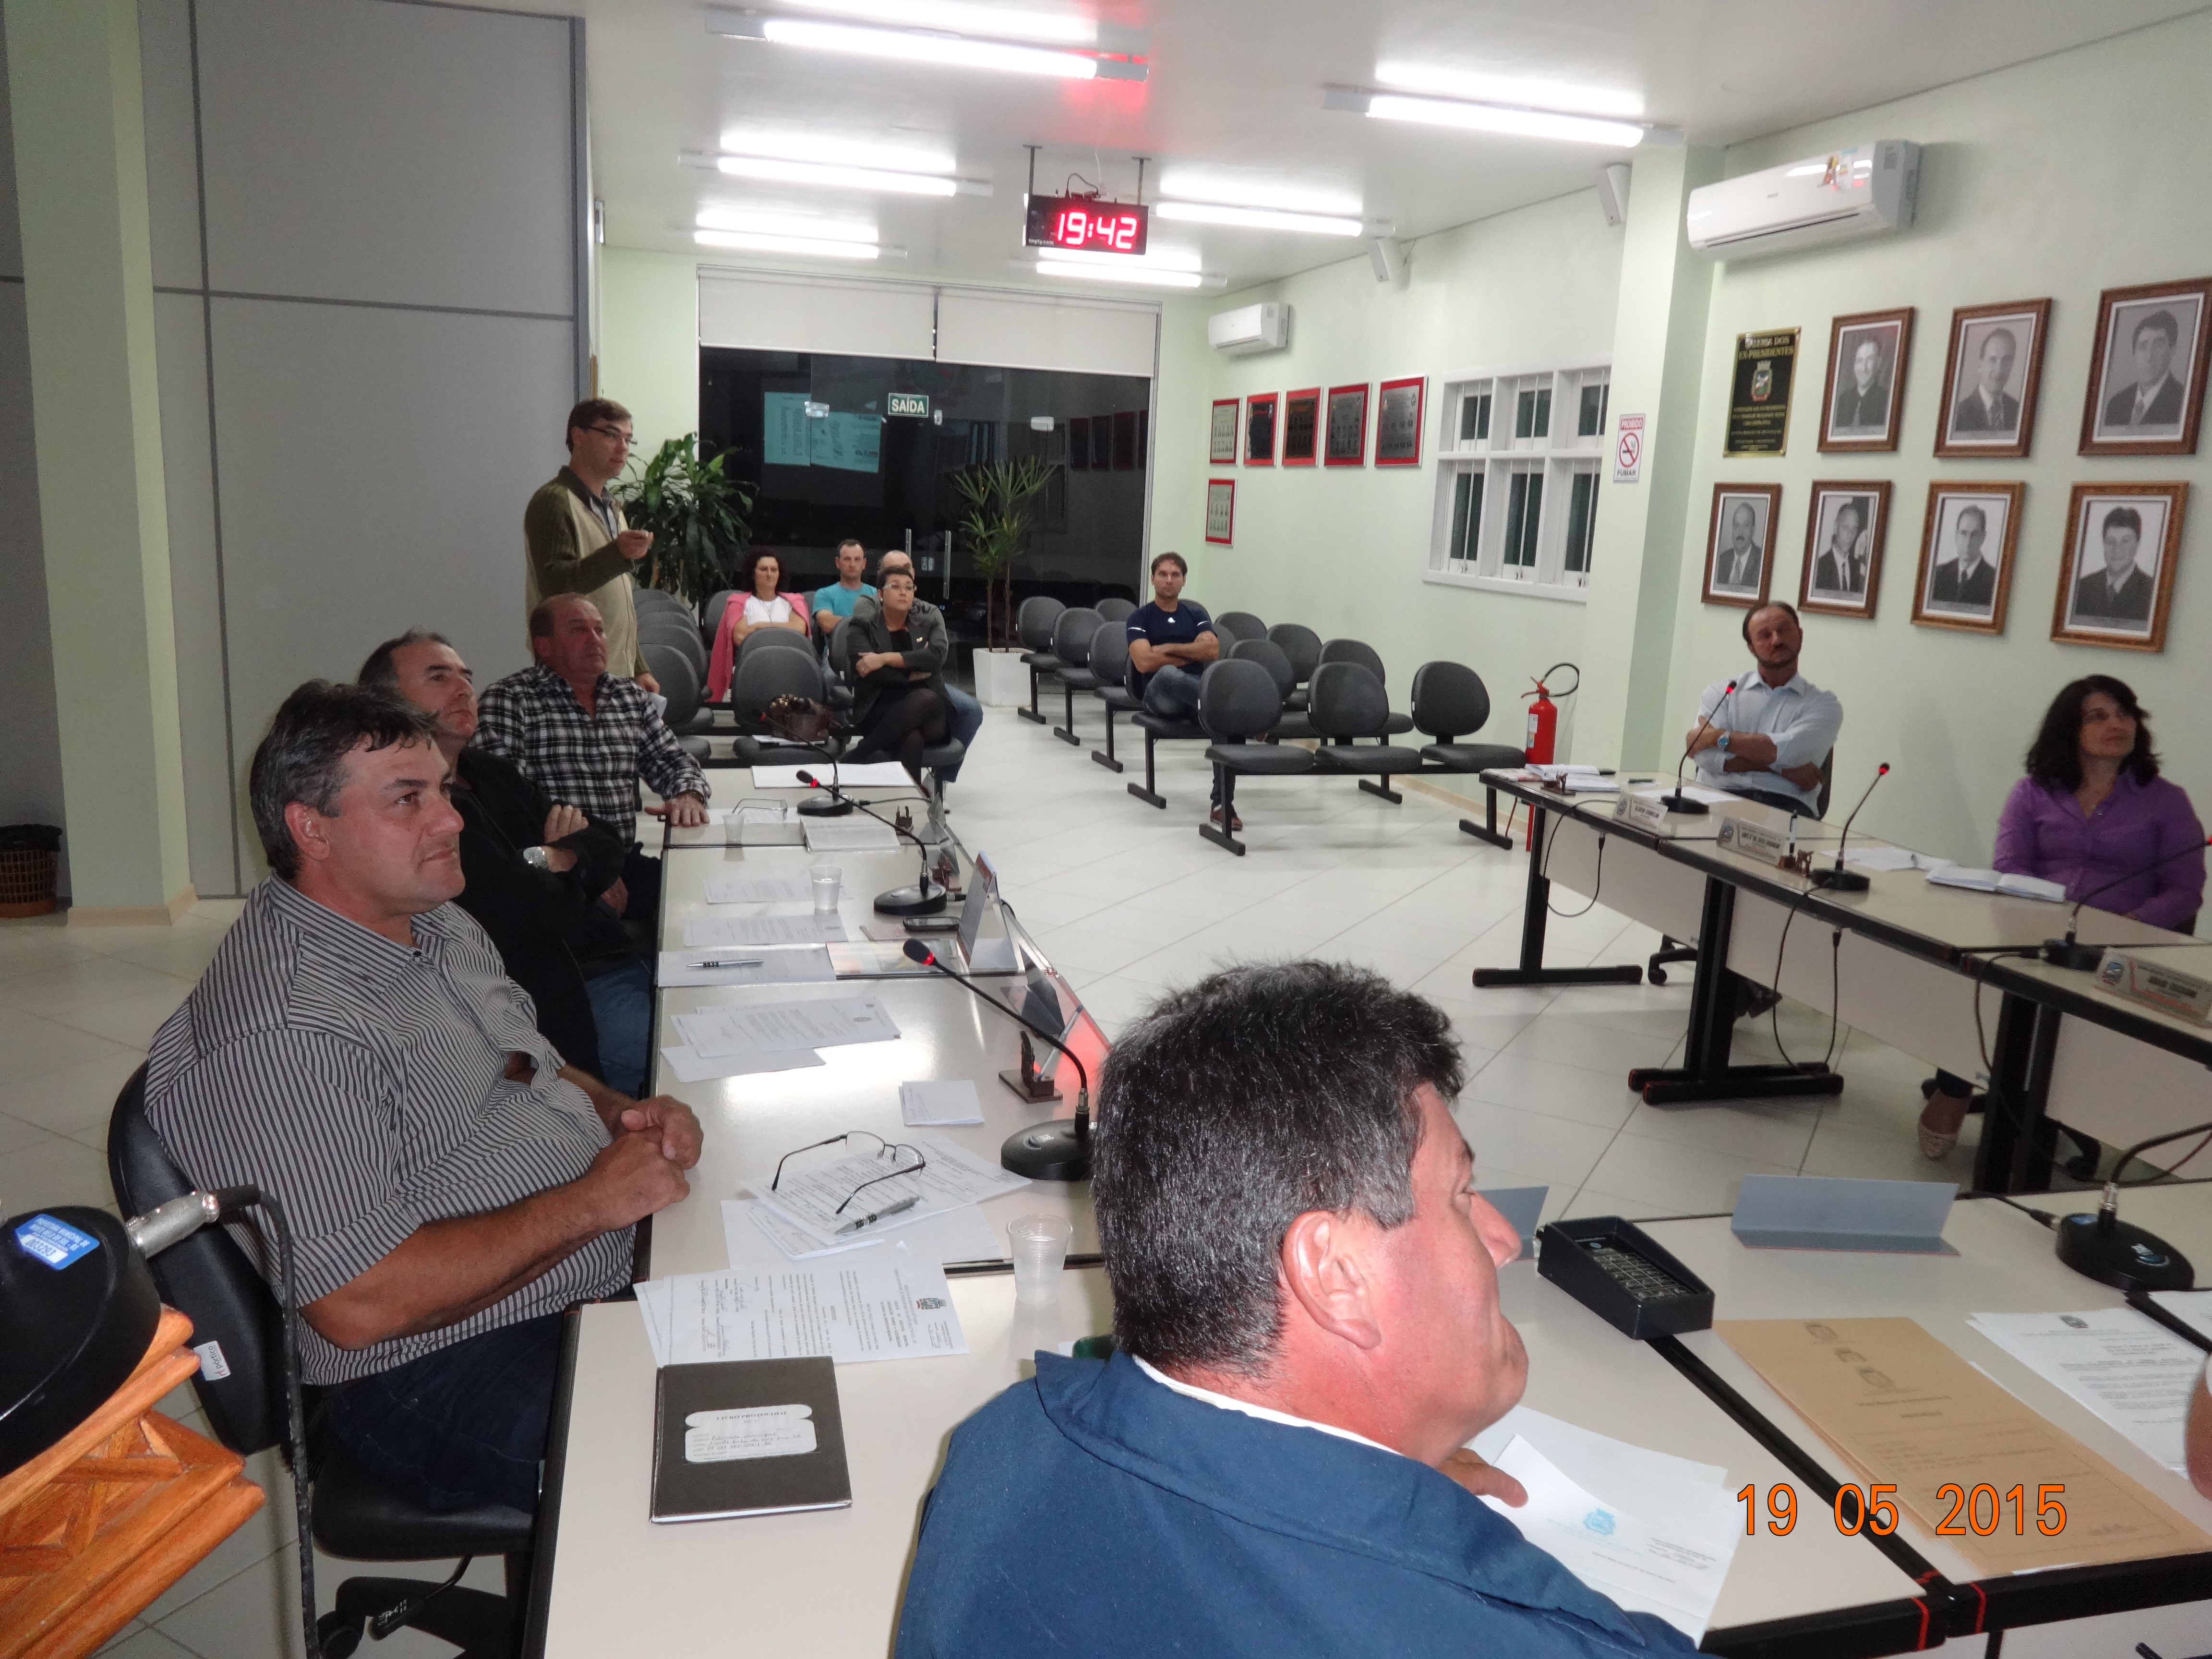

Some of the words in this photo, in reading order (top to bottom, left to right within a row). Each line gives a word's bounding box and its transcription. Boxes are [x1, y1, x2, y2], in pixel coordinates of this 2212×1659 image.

[1057, 212, 1137, 250] 19:42
[892, 397, 925, 414] SAÍDA
[25, 1239, 56, 1257] 003293
